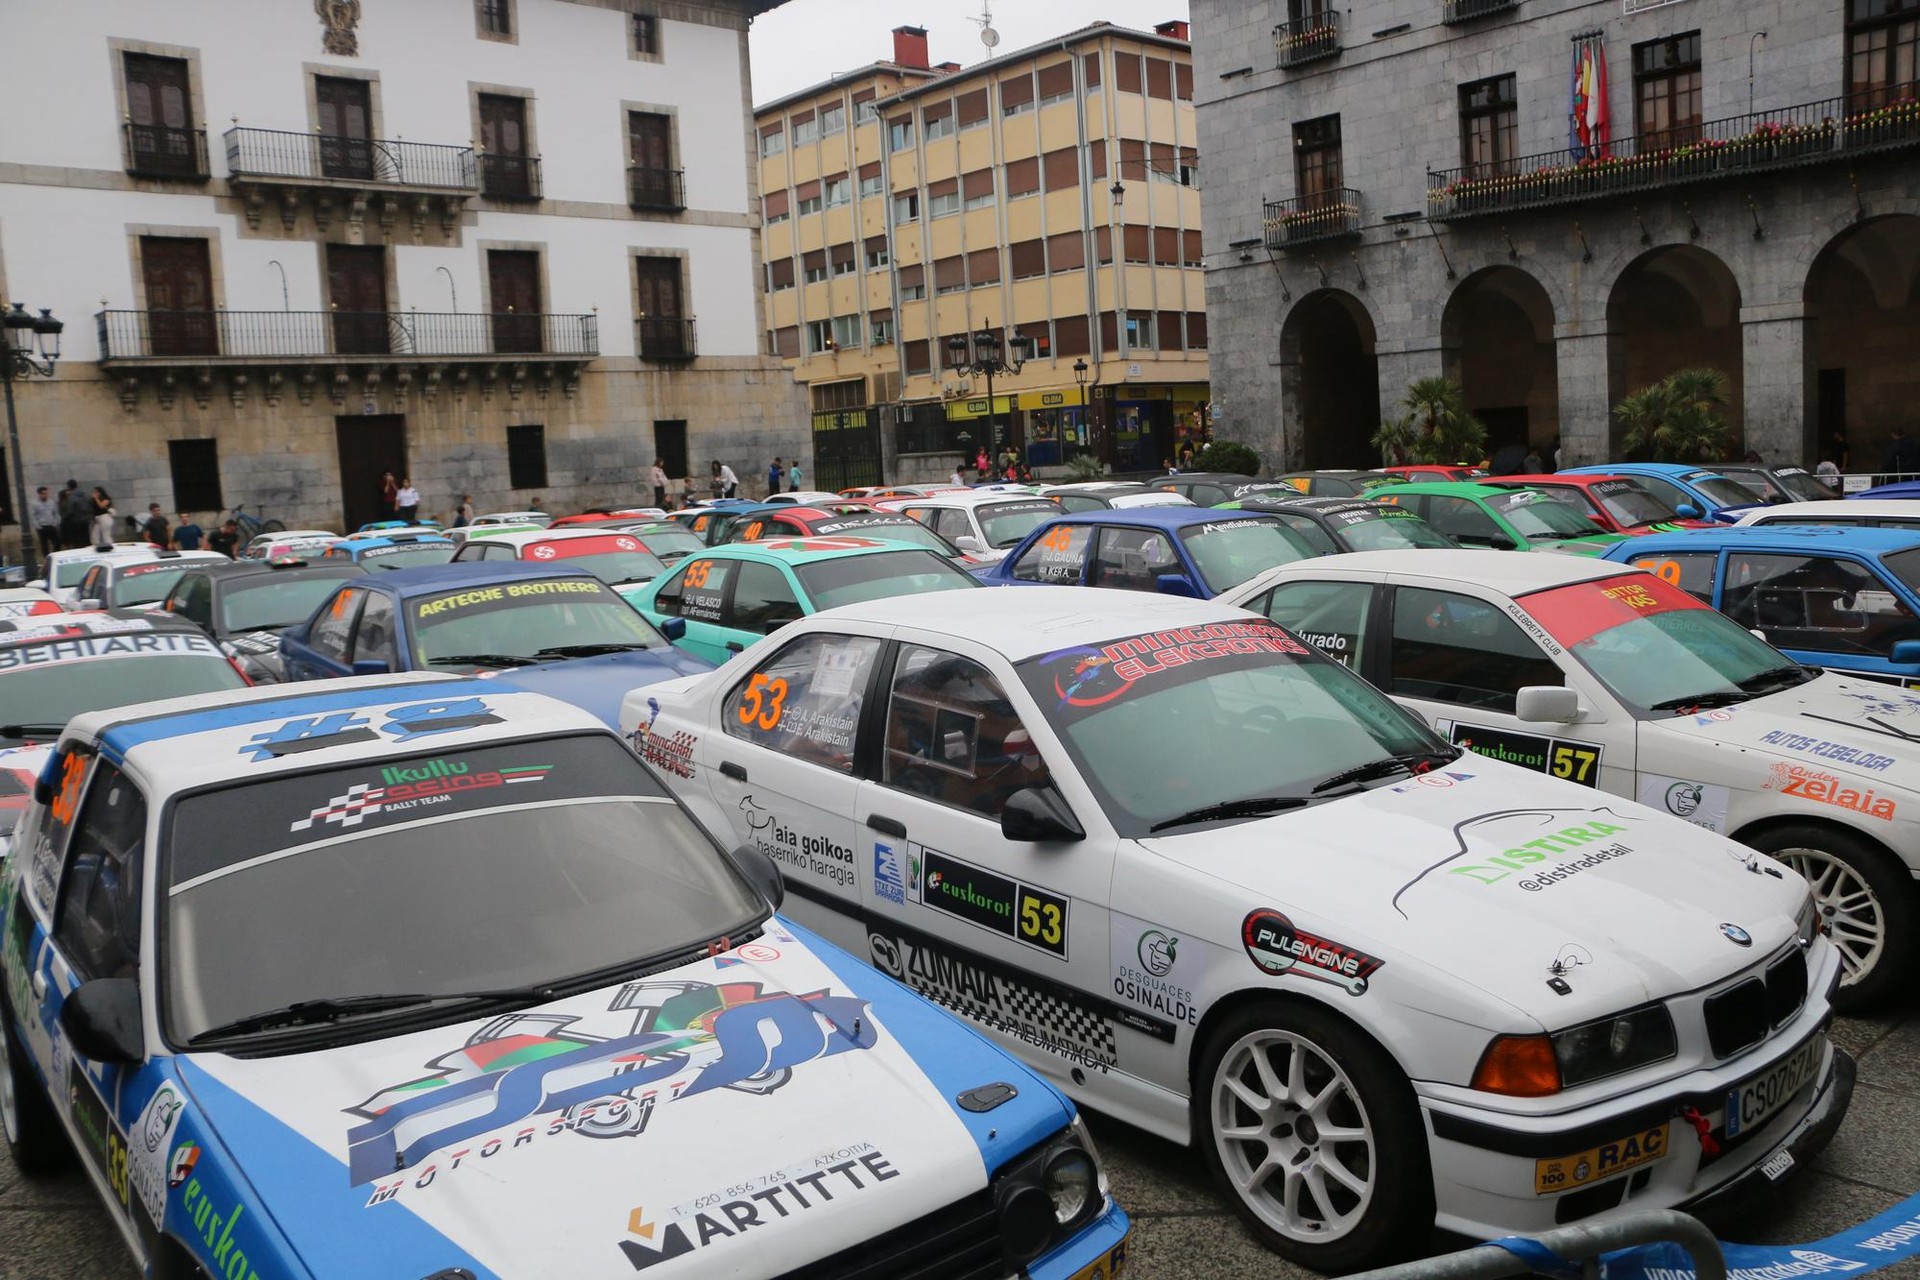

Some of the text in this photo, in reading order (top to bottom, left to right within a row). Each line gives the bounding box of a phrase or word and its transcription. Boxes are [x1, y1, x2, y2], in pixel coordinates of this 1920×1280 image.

[976, 403, 986, 411] BM
[1044, 527, 1072, 552] 46
[684, 561, 713, 587] 55
[1600, 584, 1648, 599] BITTOR
[419, 582, 601, 618] ARTECHE BROTHERS
[1621, 594, 1657, 609] KAS
[1101, 624, 1289, 662] MINGORRI
[1507, 604, 1562, 656] KULEBREITX CLUB
[1113, 637, 1310, 681] ELEKTRONIKS
[739, 673, 788, 731] 53
[804, 728, 849, 747] Arakistain
[810, 711, 854, 731] Arakistain
[648, 732, 694, 759] MINGORRI
[1472, 741, 1544, 767] euskorot
[1759, 730, 1896, 772] AUTOS RIBELOGA
[1552, 747, 1596, 781] 57
[384, 795, 452, 813] RALLY TEAM
[801, 836, 854, 864] goikoa
[1518, 843, 1635, 892] @distiradetail
[810, 854, 855, 886] haragia
[942, 882, 1011, 917] euskorot
[1021, 895, 1061, 945] 53
[1257, 928, 1360, 975] PULENGINE
[908, 942, 1004, 1012] ZUMAIA
[1119, 965, 1193, 1003] DESGUACES
[1114, 978, 1197, 1027] OSINALDE
[369, 1080, 687, 1206] MOTORSPORT
[1599, 1129, 1663, 1169] RAC
[109, 1134, 128, 1205] 33
[694, 1193, 722, 1210] 620
[726, 1182, 755, 1198] 856
[759, 1170, 787, 1187] 765
[814, 1141, 876, 1168] AZKOITIA
[1541, 1172, 1566, 1185] 100
